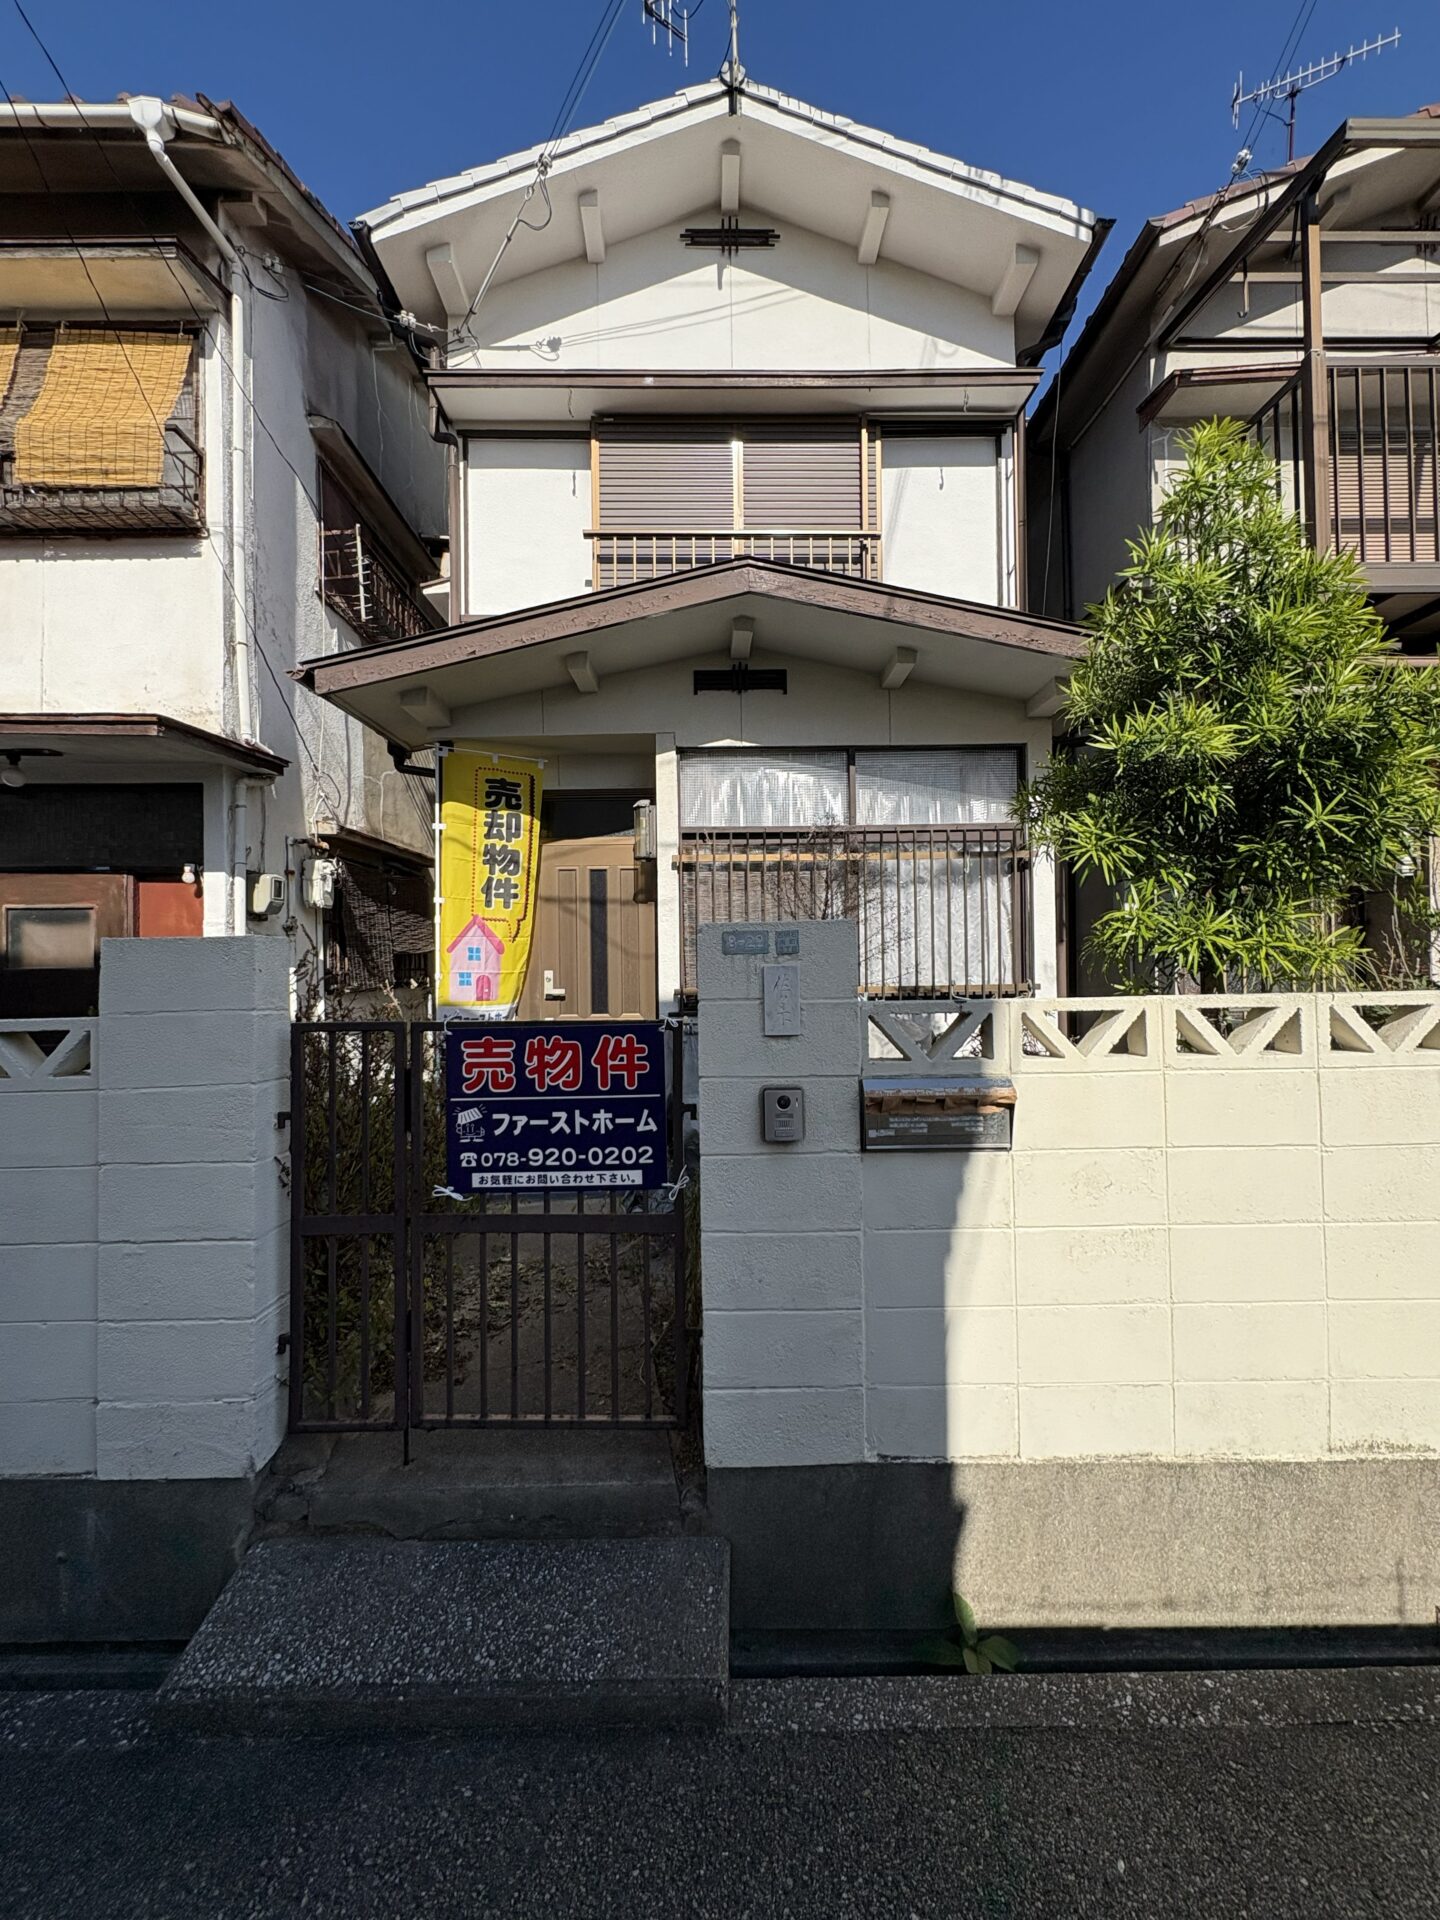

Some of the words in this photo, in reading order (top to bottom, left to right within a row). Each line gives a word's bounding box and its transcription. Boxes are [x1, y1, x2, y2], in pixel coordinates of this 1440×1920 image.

[481, 778, 523, 910] 売却物件
[461, 1034, 650, 1094] 売物件
[492, 1108, 658, 1136] ファーストホーム
[481, 1146, 654, 1168] 078-920-0202
[478, 1173, 636, 1186] お気軽にお問い合わせ下さい。
